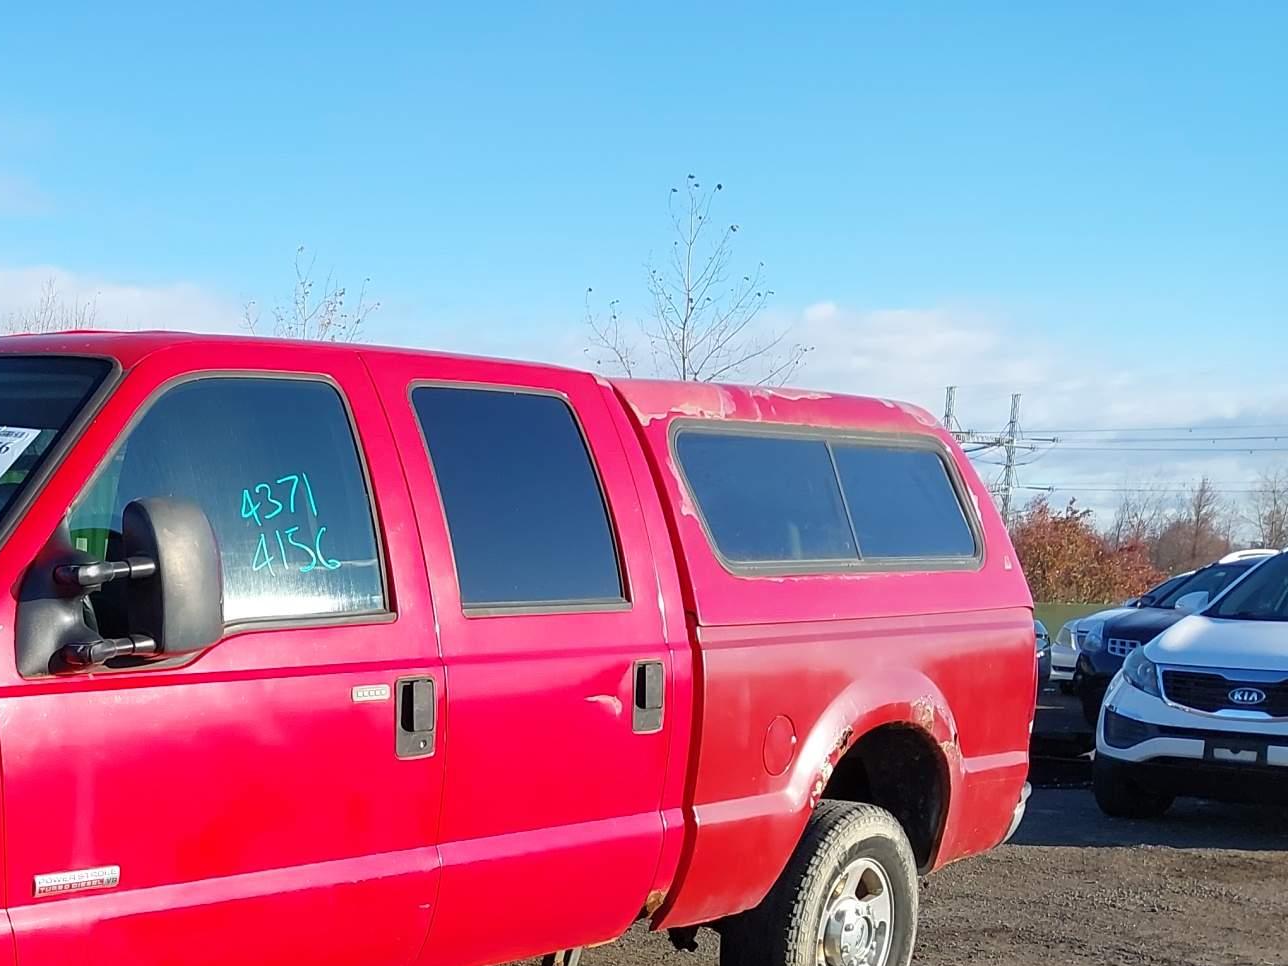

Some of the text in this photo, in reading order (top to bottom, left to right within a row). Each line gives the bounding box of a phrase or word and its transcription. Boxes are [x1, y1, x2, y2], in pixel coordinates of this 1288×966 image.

[241, 472, 318, 526] 4371
[252, 526, 342, 577] 4156
[1233, 690, 1258, 701] KIA
